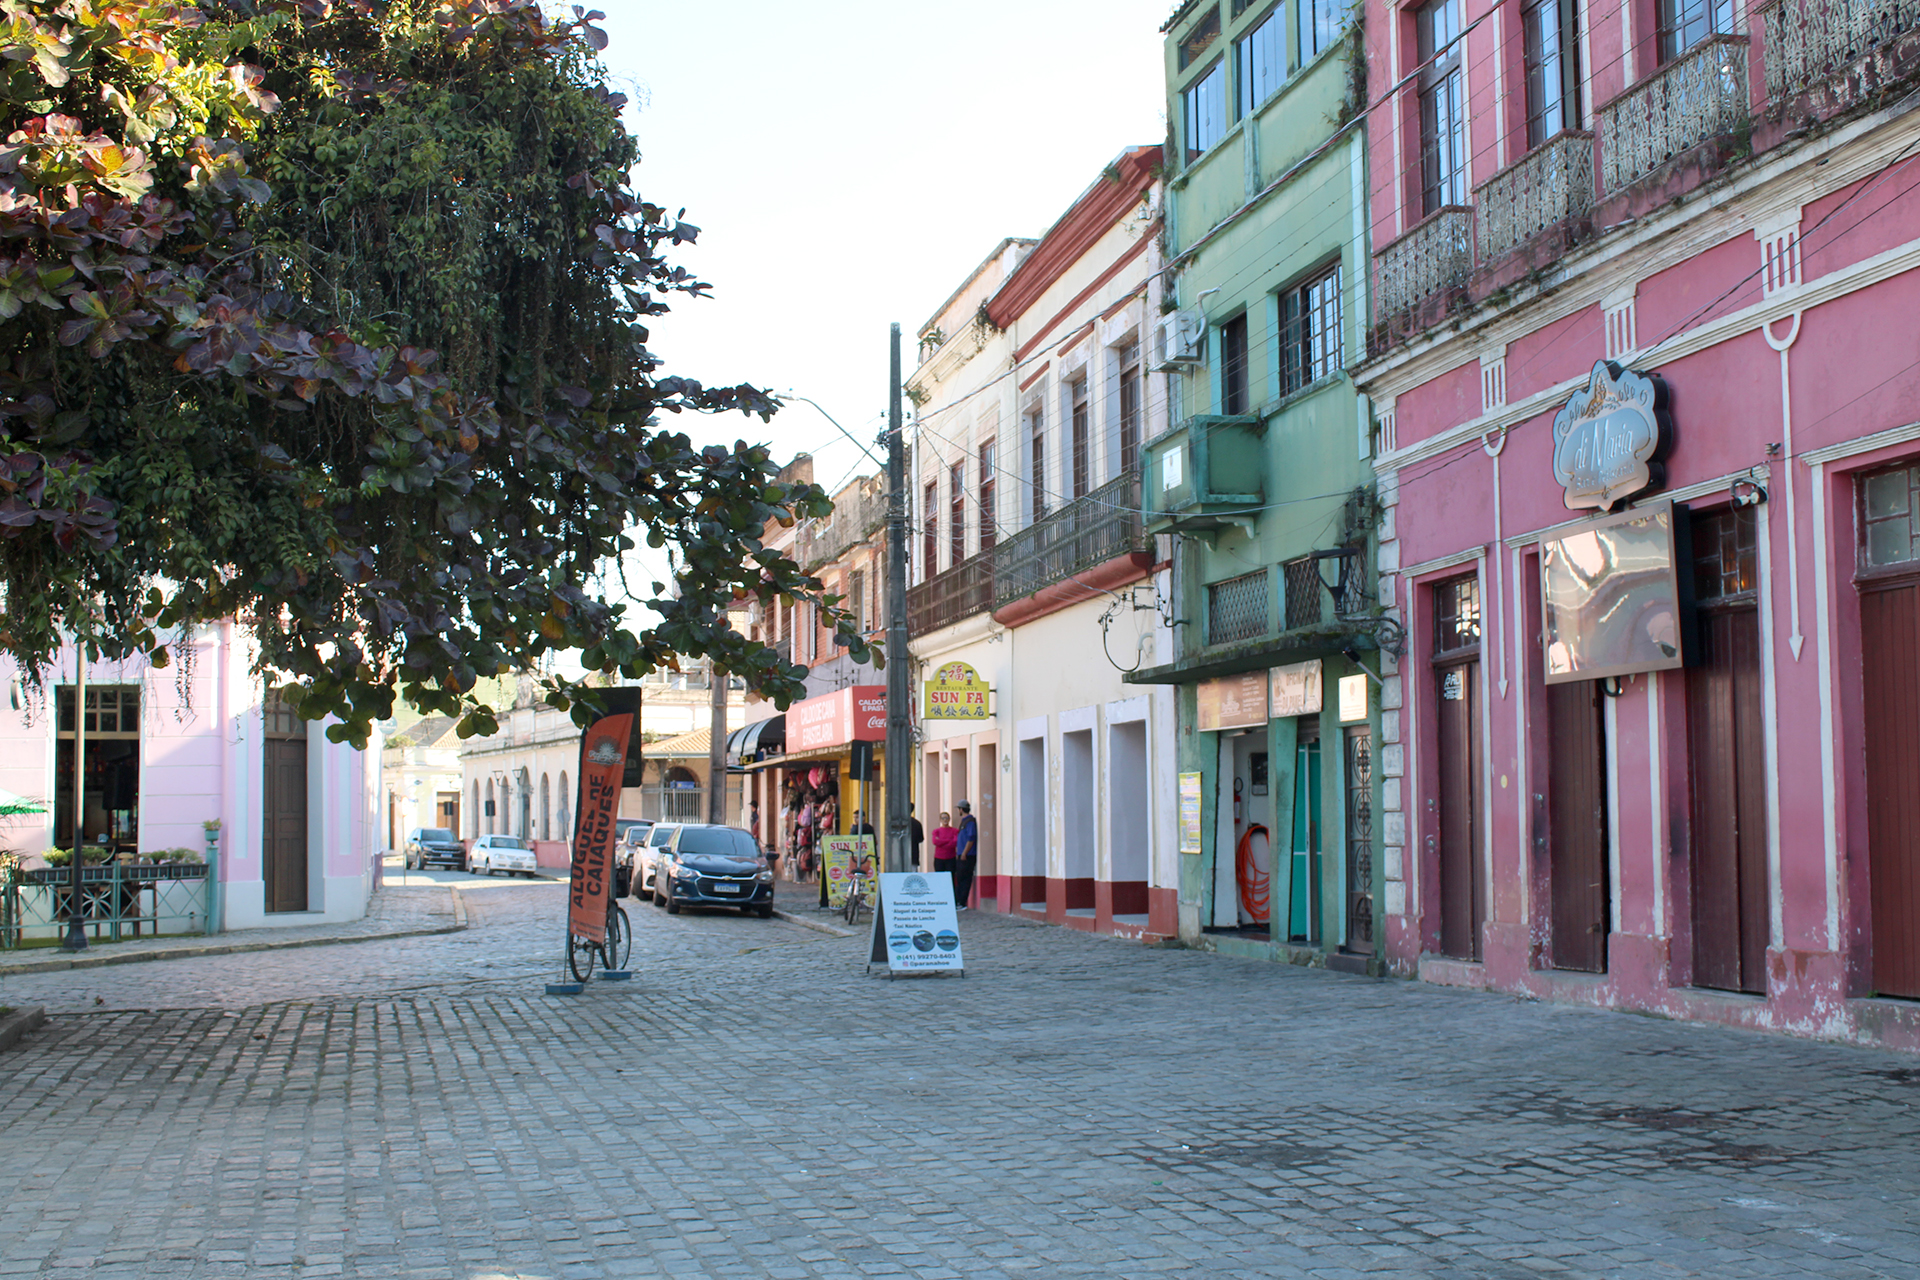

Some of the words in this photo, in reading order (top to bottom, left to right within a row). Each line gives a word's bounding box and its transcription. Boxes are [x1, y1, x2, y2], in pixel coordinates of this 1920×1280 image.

[1574, 430, 1588, 471] di
[1590, 418, 1634, 472] Maria
[948, 664, 965, 682] 福
[931, 691, 959, 704] SUN
[966, 692, 985, 704] FA
[801, 704, 815, 725] CALDO
[822, 699, 836, 720] CANA
[806, 722, 834, 745] PASTELARIA
[586, 785, 614, 896] CAIAQUES
[830, 842, 850, 850] SUN
